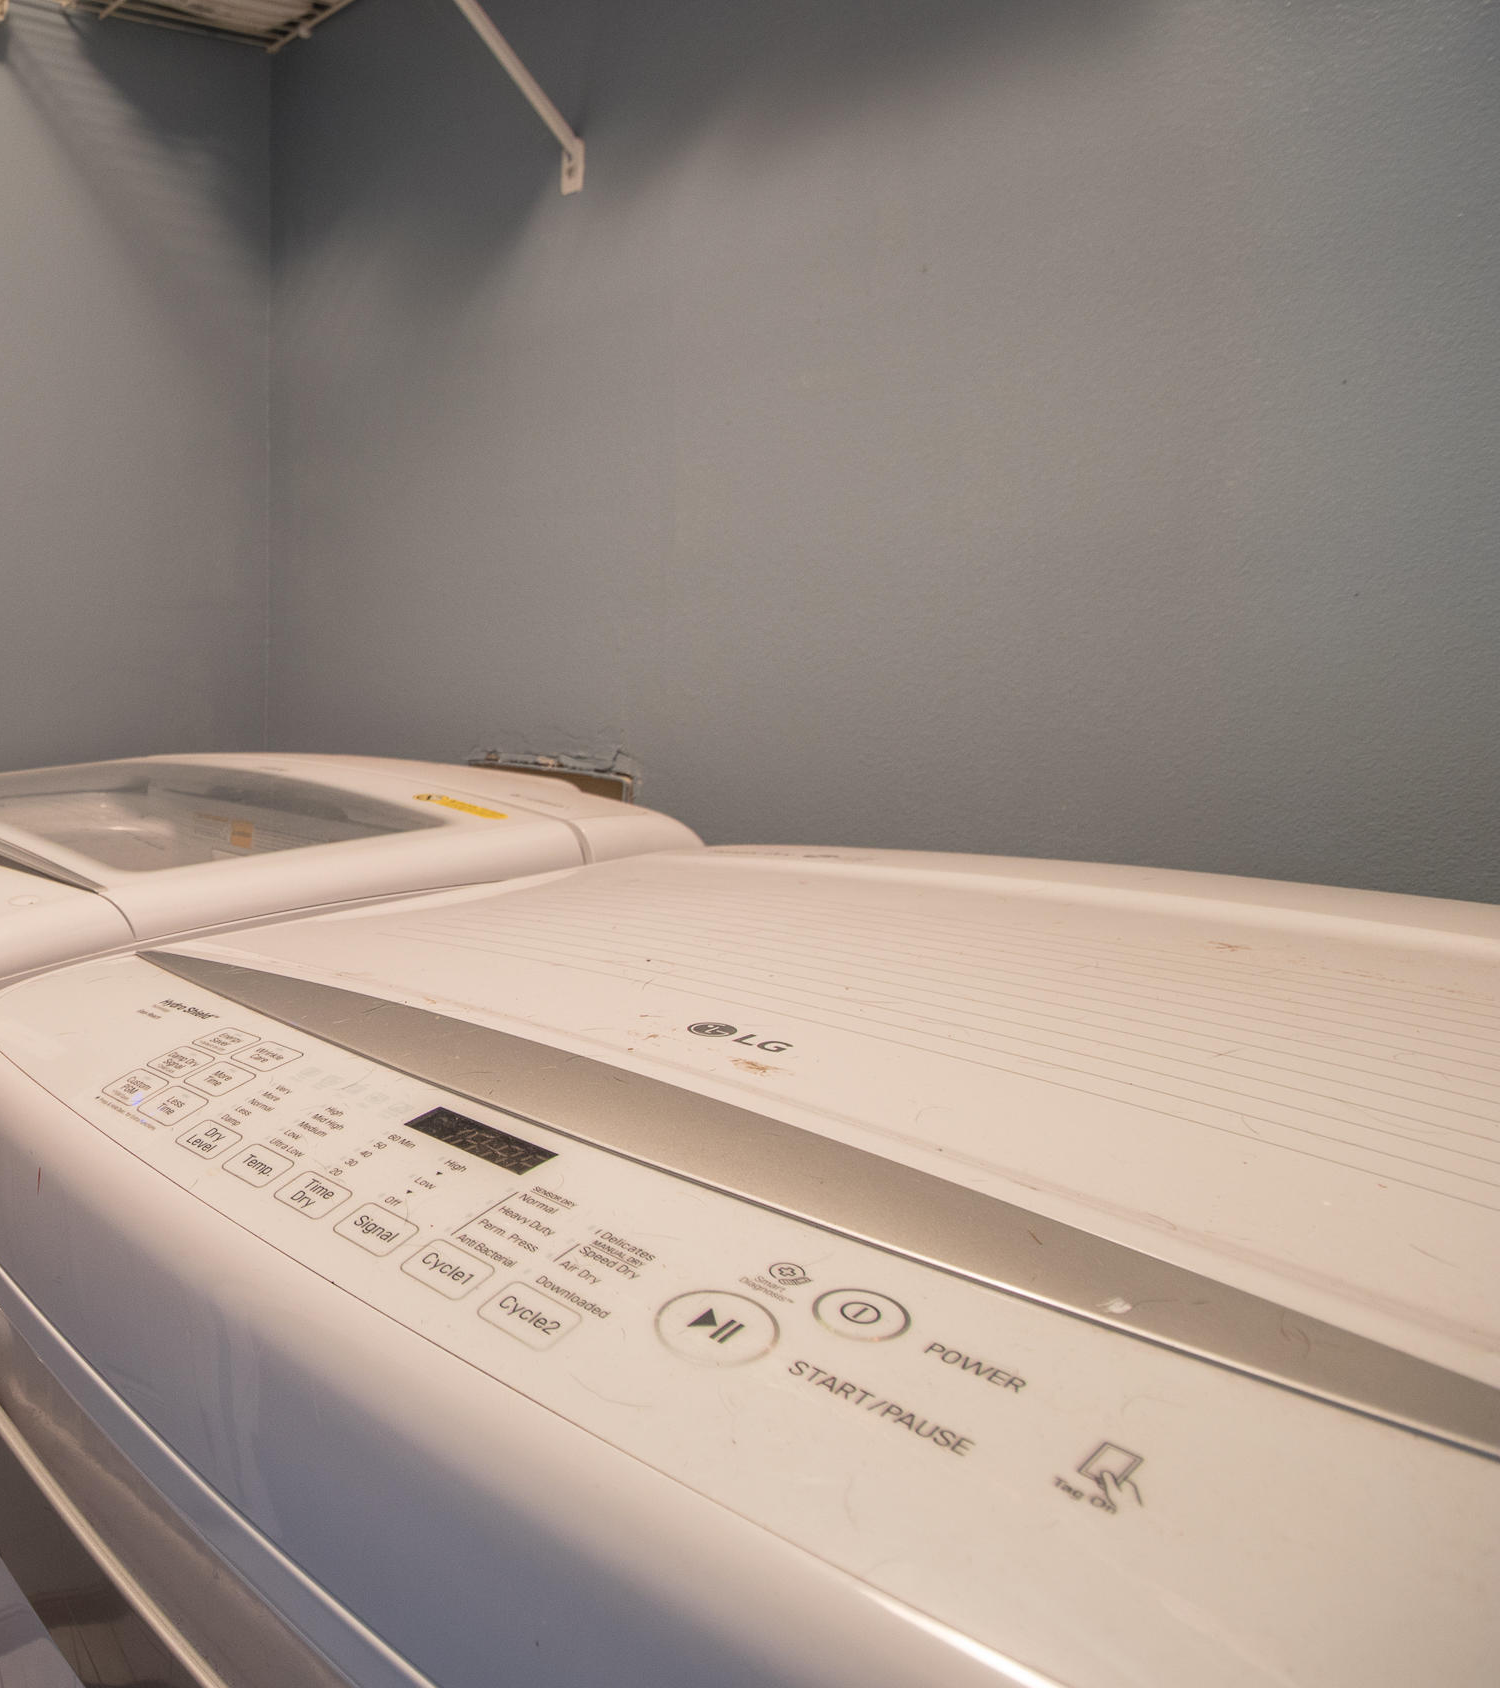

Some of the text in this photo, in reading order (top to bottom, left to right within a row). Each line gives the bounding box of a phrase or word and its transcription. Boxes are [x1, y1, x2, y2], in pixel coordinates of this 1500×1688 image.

[732, 1034, 794, 1052] LG
[126, 1075, 152, 1091] Custom
[203, 1075, 223, 1087] Time
[213, 1070, 233, 1082] More
[262, 1090, 281, 1102] More
[276, 1084, 292, 1095] Very
[157, 1102, 175, 1116] Time
[166, 1095, 186, 1109] Less
[250, 1098, 276, 1113] Normal
[220, 1113, 241, 1127] Damp
[234, 1106, 253, 1117] Less
[324, 1106, 344, 1118] High
[299, 1120, 328, 1138] Medium
[311, 1113, 345, 1131] Mid High
[186, 1133, 218, 1153] Level
[204, 1126, 227, 1143] Dry
[283, 1129, 303, 1141] Low
[387, 1133, 417, 1150] 60 Min
[268, 1136, 306, 1159] Ultra Low
[360, 1150, 373, 1158] 40
[373, 1141, 388, 1150] 50
[242, 1153, 274, 1177] Temp.
[344, 1158, 359, 1167] 30
[443, 1158, 467, 1173] High
[328, 1167, 343, 1177] 20
[304, 1178, 336, 1200] Time
[413, 1176, 437, 1191] Low
[290, 1190, 316, 1209] Dry
[384, 1195, 404, 1207] Off
[518, 1193, 560, 1216] Normal
[531, 1185, 578, 1208] SENSOR DRY
[353, 1214, 400, 1244] Signal
[498, 1205, 556, 1237] Heavy Duty
[477, 1218, 540, 1254] Perm. Press
[591, 1239, 647, 1269] MANUAL DRY
[599, 1231, 656, 1262] Delicates
[421, 1251, 475, 1286] Cycle1
[578, 1245, 642, 1281] Speed Dry
[558, 1260, 603, 1286] Air Dry
[754, 1274, 786, 1293] Smart
[534, 1275, 613, 1320] Downloaded
[498, 1294, 562, 1336] Cycle2
[923, 1342, 1029, 1394] POWER
[787, 1360, 978, 1458] START/PAUSE
[1054, 1476, 1085, 1501] Tag
